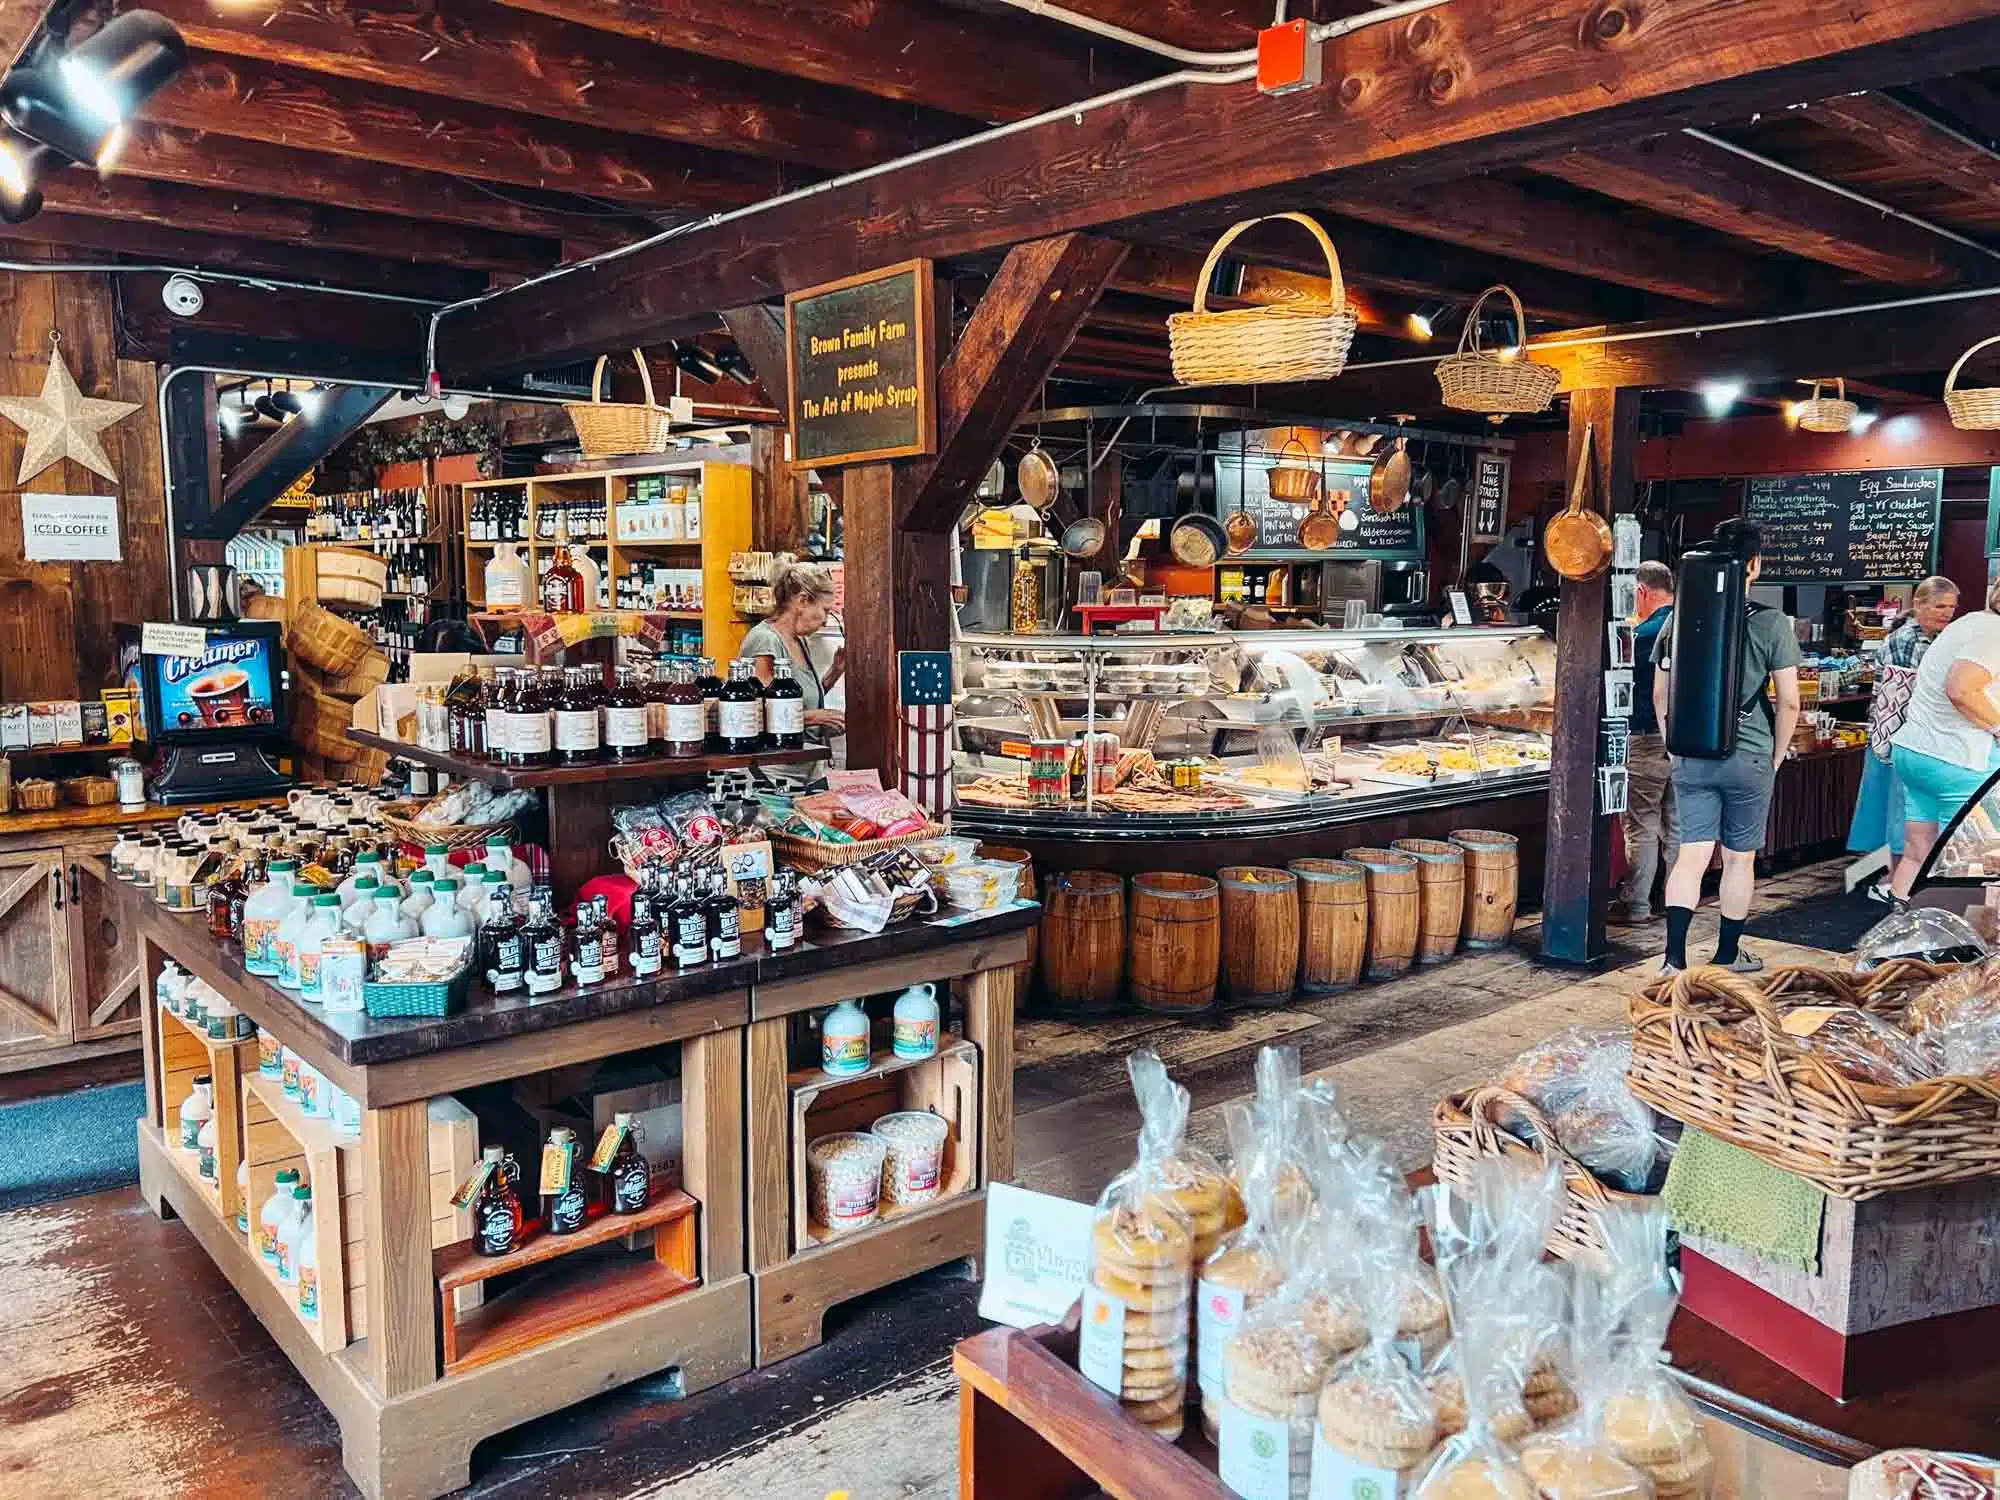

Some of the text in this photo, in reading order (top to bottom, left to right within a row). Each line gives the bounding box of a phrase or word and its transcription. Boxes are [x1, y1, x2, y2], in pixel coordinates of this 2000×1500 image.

[810, 319, 906, 357] Brown Family Farm
[837, 359, 879, 388] presents
[802, 384, 918, 419] The Art of Maple Syrup
[1483, 463, 1499, 475] DELI
[1482, 475, 1499, 487] LINE
[1859, 475, 1937, 499] Egg Sandwiches
[1479, 485, 1500, 498] STARTS
[1480, 498, 1497, 511] HERE
[1849, 500, 1866, 515] Egg
[1868, 512, 1887, 524] your
[33, 523, 110, 536] ICED COFFEE
[164, 640, 258, 682] Creamer
[619, 1180, 647, 1196] Maple
[553, 1198, 584, 1215] Maple
[481, 1218, 514, 1236] Maple
